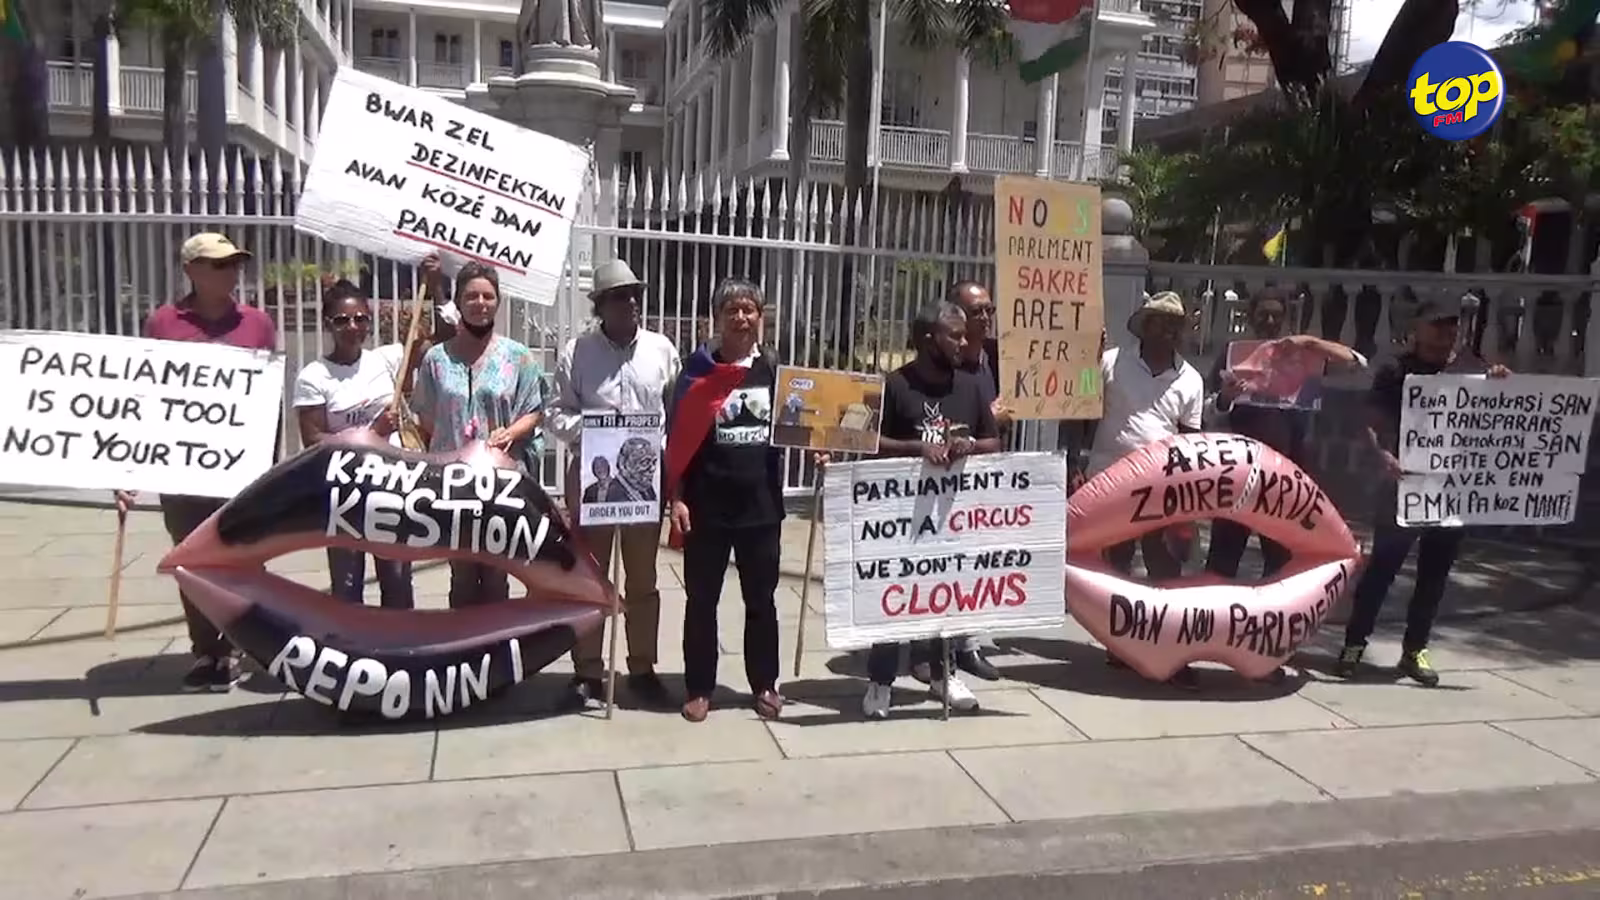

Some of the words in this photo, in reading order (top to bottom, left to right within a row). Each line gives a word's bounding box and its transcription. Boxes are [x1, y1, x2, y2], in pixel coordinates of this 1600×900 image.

[366, 92, 434, 132] BWAR
[445, 119, 495, 151] ZEL
[411, 142, 565, 211] DEZINFEKTAN
[345, 159, 407, 190] AVAN
[491, 206, 542, 237] DAN
[397, 209, 532, 268] PARLEMAN
[1017, 266, 1089, 295] SAKRÉ
[1012, 298, 1086, 331] ARET
[1028, 340, 1069, 361] FER
[20, 347, 262, 395] PARLIAMENT
[27, 389, 55, 413] IS
[70, 393, 142, 421] OUR
[160, 397, 245, 427] TOOL
[1428, 411, 1563, 433] TRANSPARANS
[1549, 393, 1592, 416] SAN
[3, 426, 82, 459] NOT
[92, 430, 171, 466] YOUR
[176, 441, 245, 470] TOY
[1163, 437, 1257, 477] ARET
[1534, 431, 1582, 454] SAN
[326, 450, 428, 493] KAN
[443, 461, 526, 509] POZ
[853, 471, 1004, 504] PARLIAMENT
[1011, 471, 1030, 489] IS
[1130, 466, 1235, 523] ZOURÉ
[589, 506, 616, 517] ORDER
[618, 505, 634, 517] YOU
[634, 504, 650, 516] OUT
[861, 517, 912, 540] NOT
[918, 516, 937, 535] A
[949, 504, 1033, 533] CIRCUS
[1404, 492, 1442, 520] PM
[856, 559, 890, 580] WE
[898, 555, 967, 577] DON'T
[974, 550, 1031, 570] NEED
[881, 572, 1028, 617] CLOWNS
[1108, 594, 1169, 645] DAN
[1176, 607, 1215, 645] NOU
